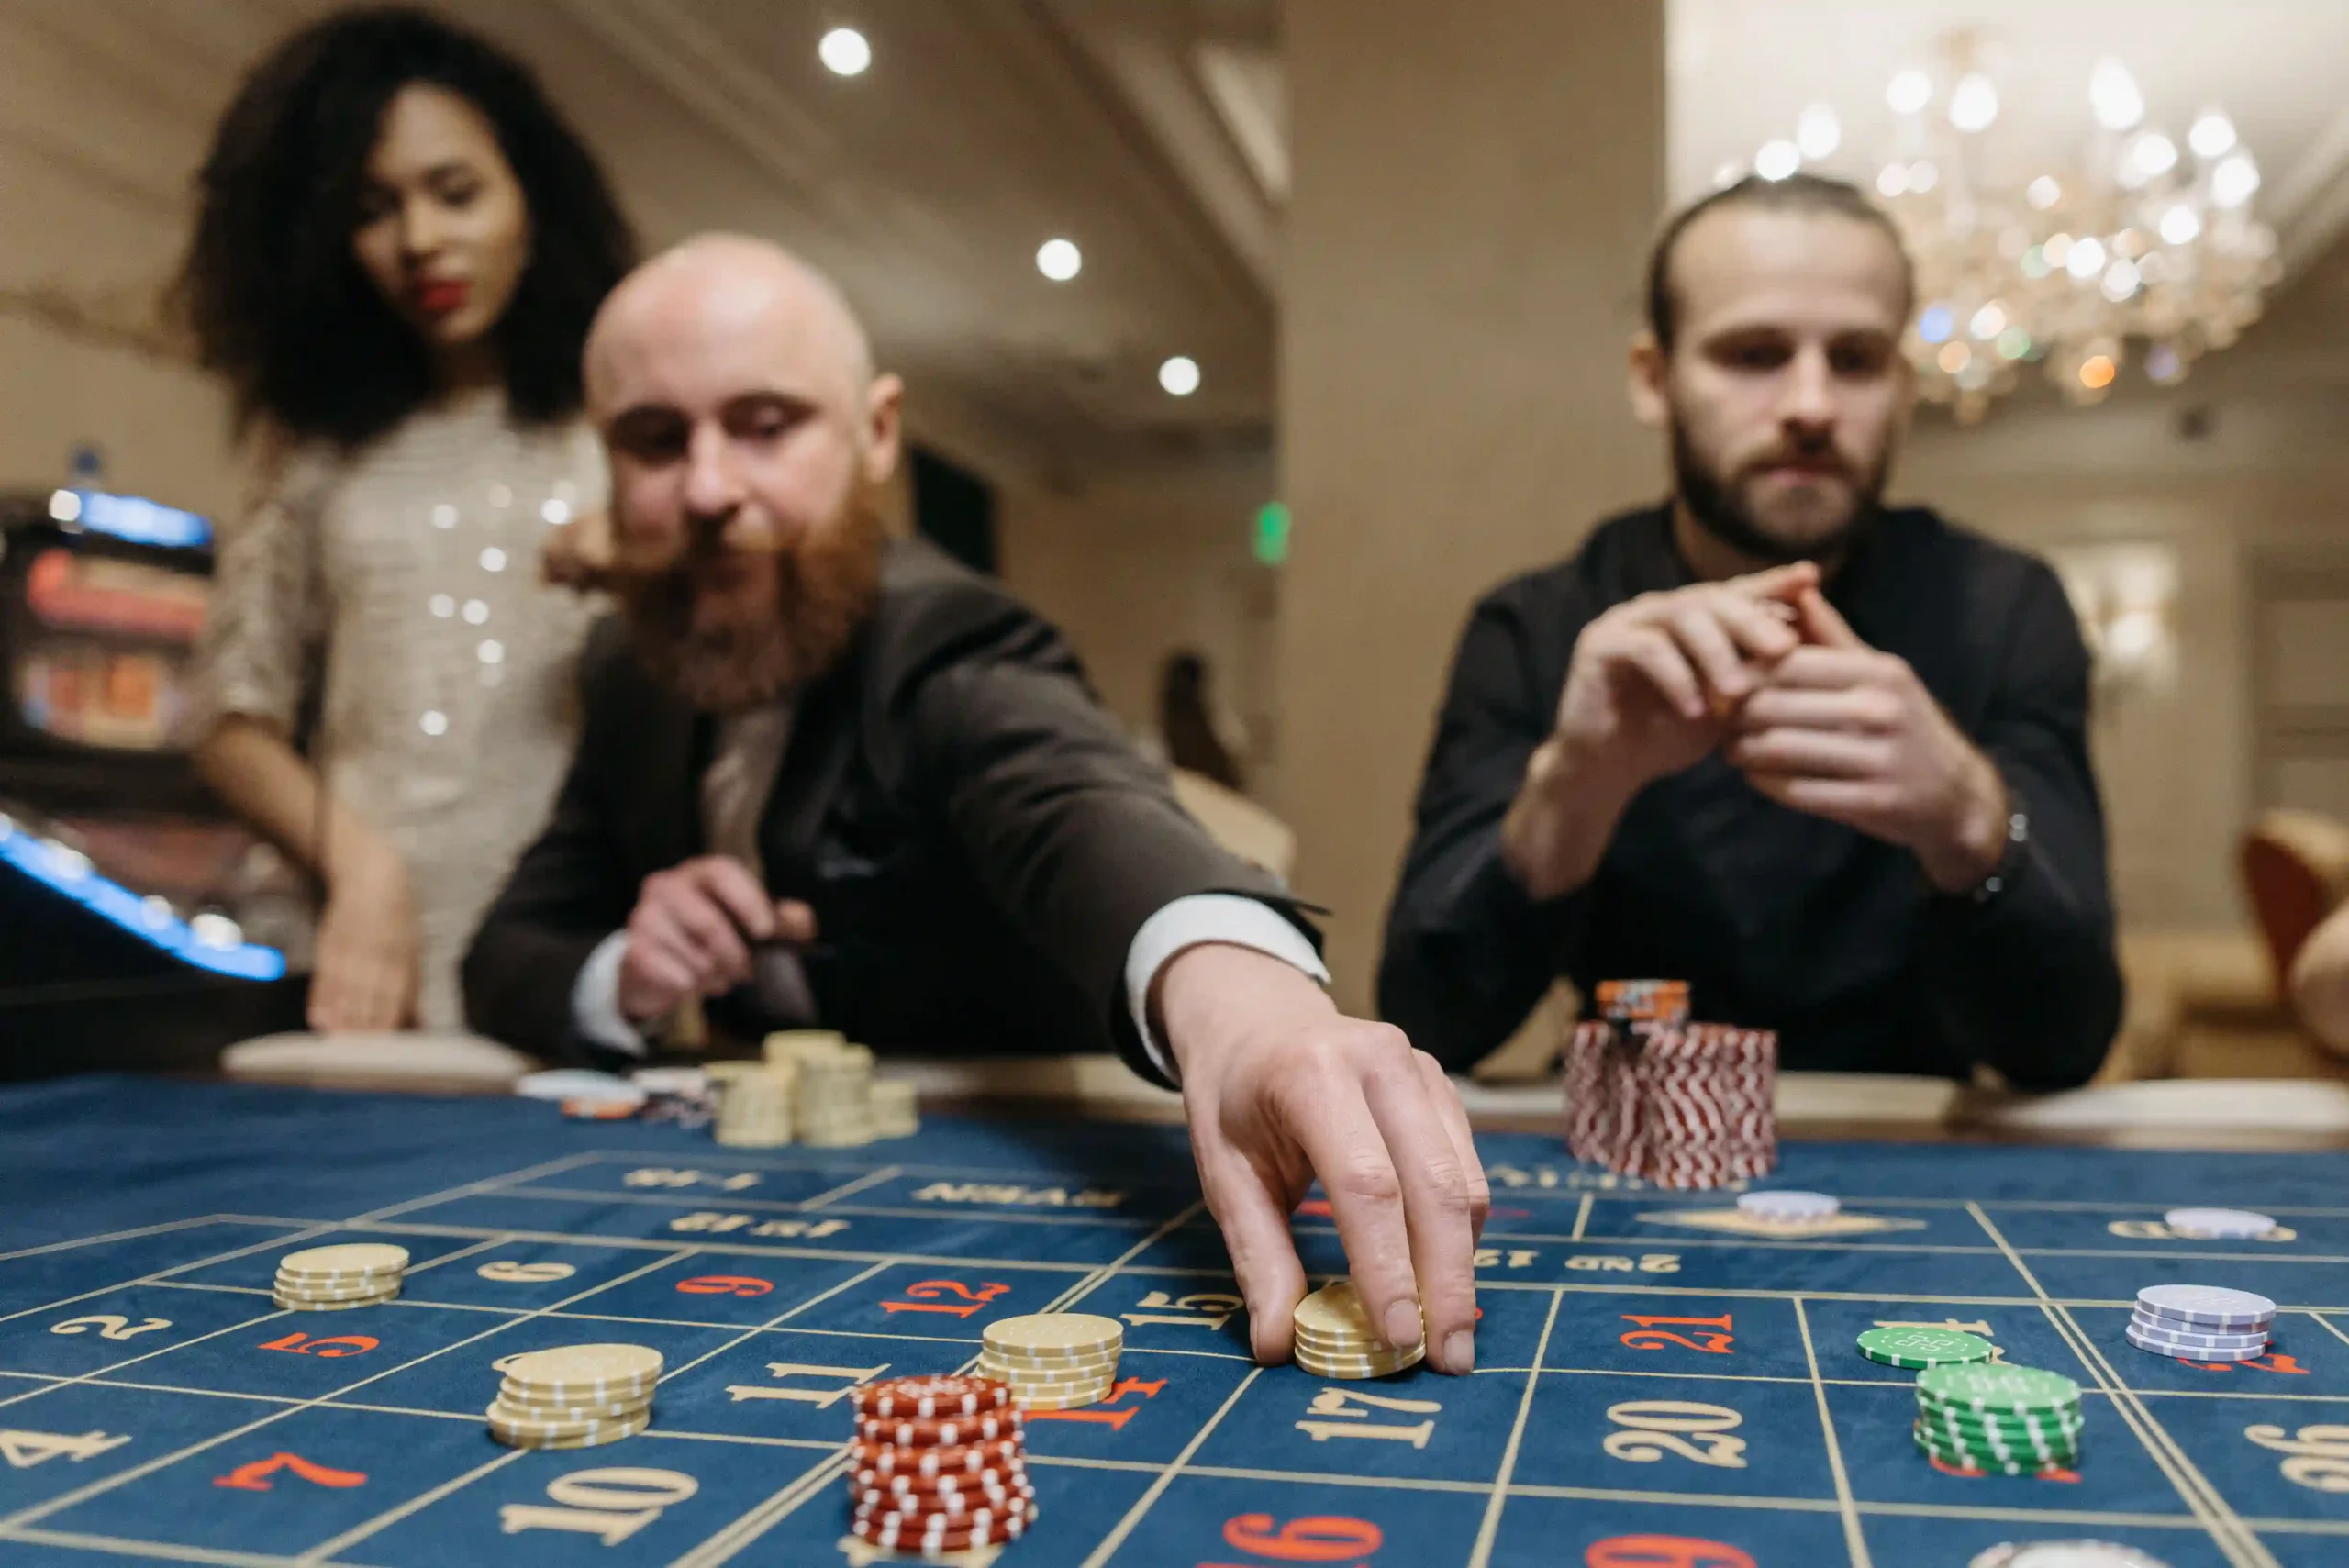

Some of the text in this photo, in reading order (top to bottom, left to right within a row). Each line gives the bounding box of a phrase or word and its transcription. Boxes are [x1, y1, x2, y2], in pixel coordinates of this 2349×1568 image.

[476, 1261, 576, 1283] 6
[1474, 1249, 1681, 1273] 2ND 12
[674, 1274, 775, 1297] 9
[880, 1280, 1012, 1319] 12
[50, 1315, 172, 1341] 2
[1119, 1290, 1247, 1331] 15
[257, 1332, 381, 1359] 5
[1620, 1313, 1736, 1354] 21
[725, 1362, 892, 1410] 11
[1295, 1386, 1442, 1450] 17
[1603, 1399, 1748, 1469] 20
[0, 1429, 132, 1468] 4
[213, 1451, 368, 1492] 7
[498, 1466, 700, 1549] 10
[1197, 1512, 1384, 1568] 6
